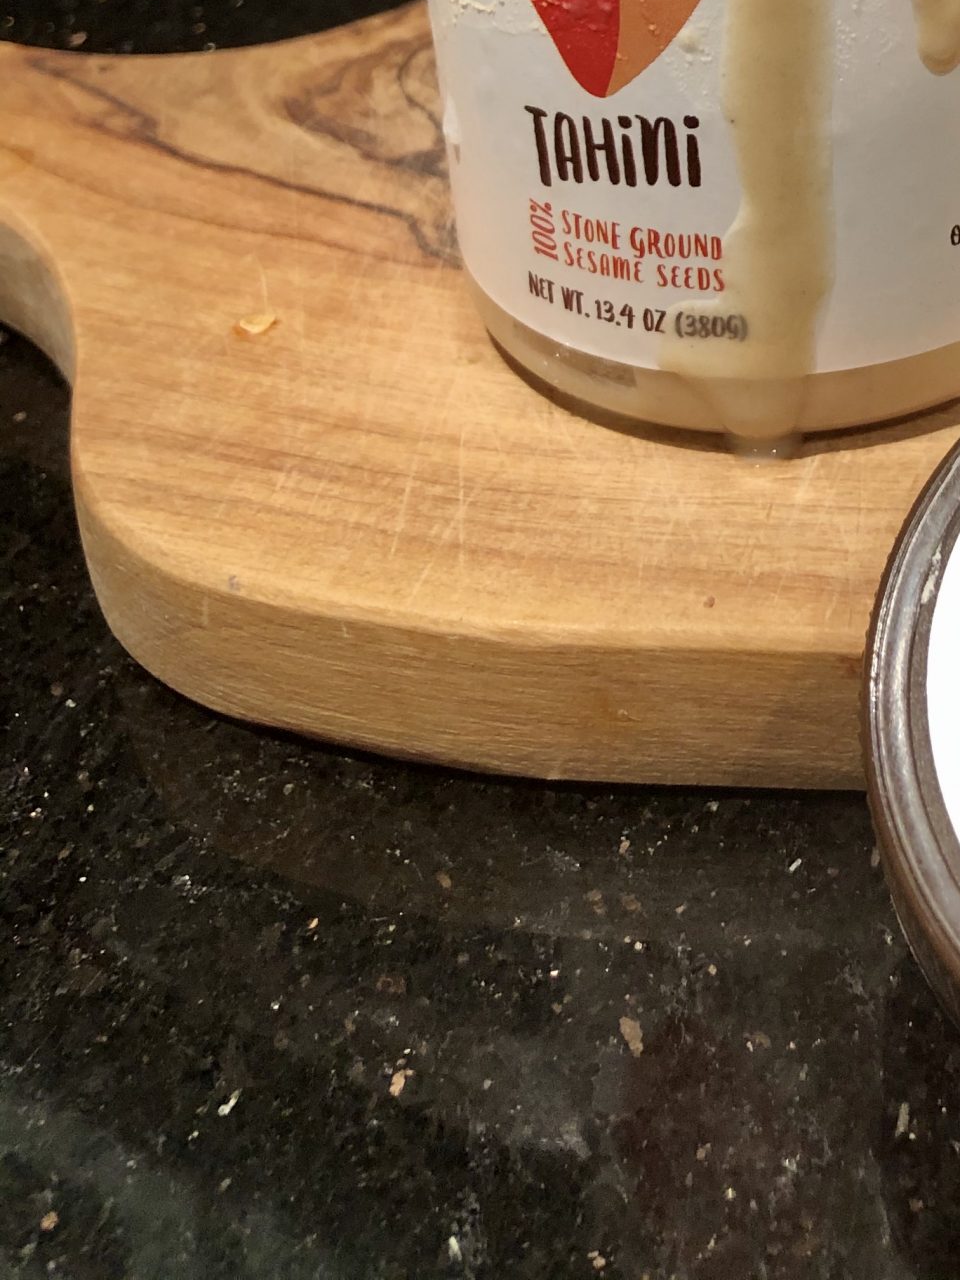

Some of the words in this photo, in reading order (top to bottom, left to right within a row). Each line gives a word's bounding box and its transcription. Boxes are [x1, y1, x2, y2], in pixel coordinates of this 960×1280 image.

[529, 198, 559, 261] 100%
[561, 209, 620, 250] STONE
[630, 227, 723, 261] GROUND
[564, 242, 645, 283] SESAME
[657, 265, 725, 292] SEEDS
[528, 271, 554, 304] NET
[561, 286, 590, 318] WT.
[595, 299, 635, 329] 13.4
[643, 308, 667, 333] OZ
